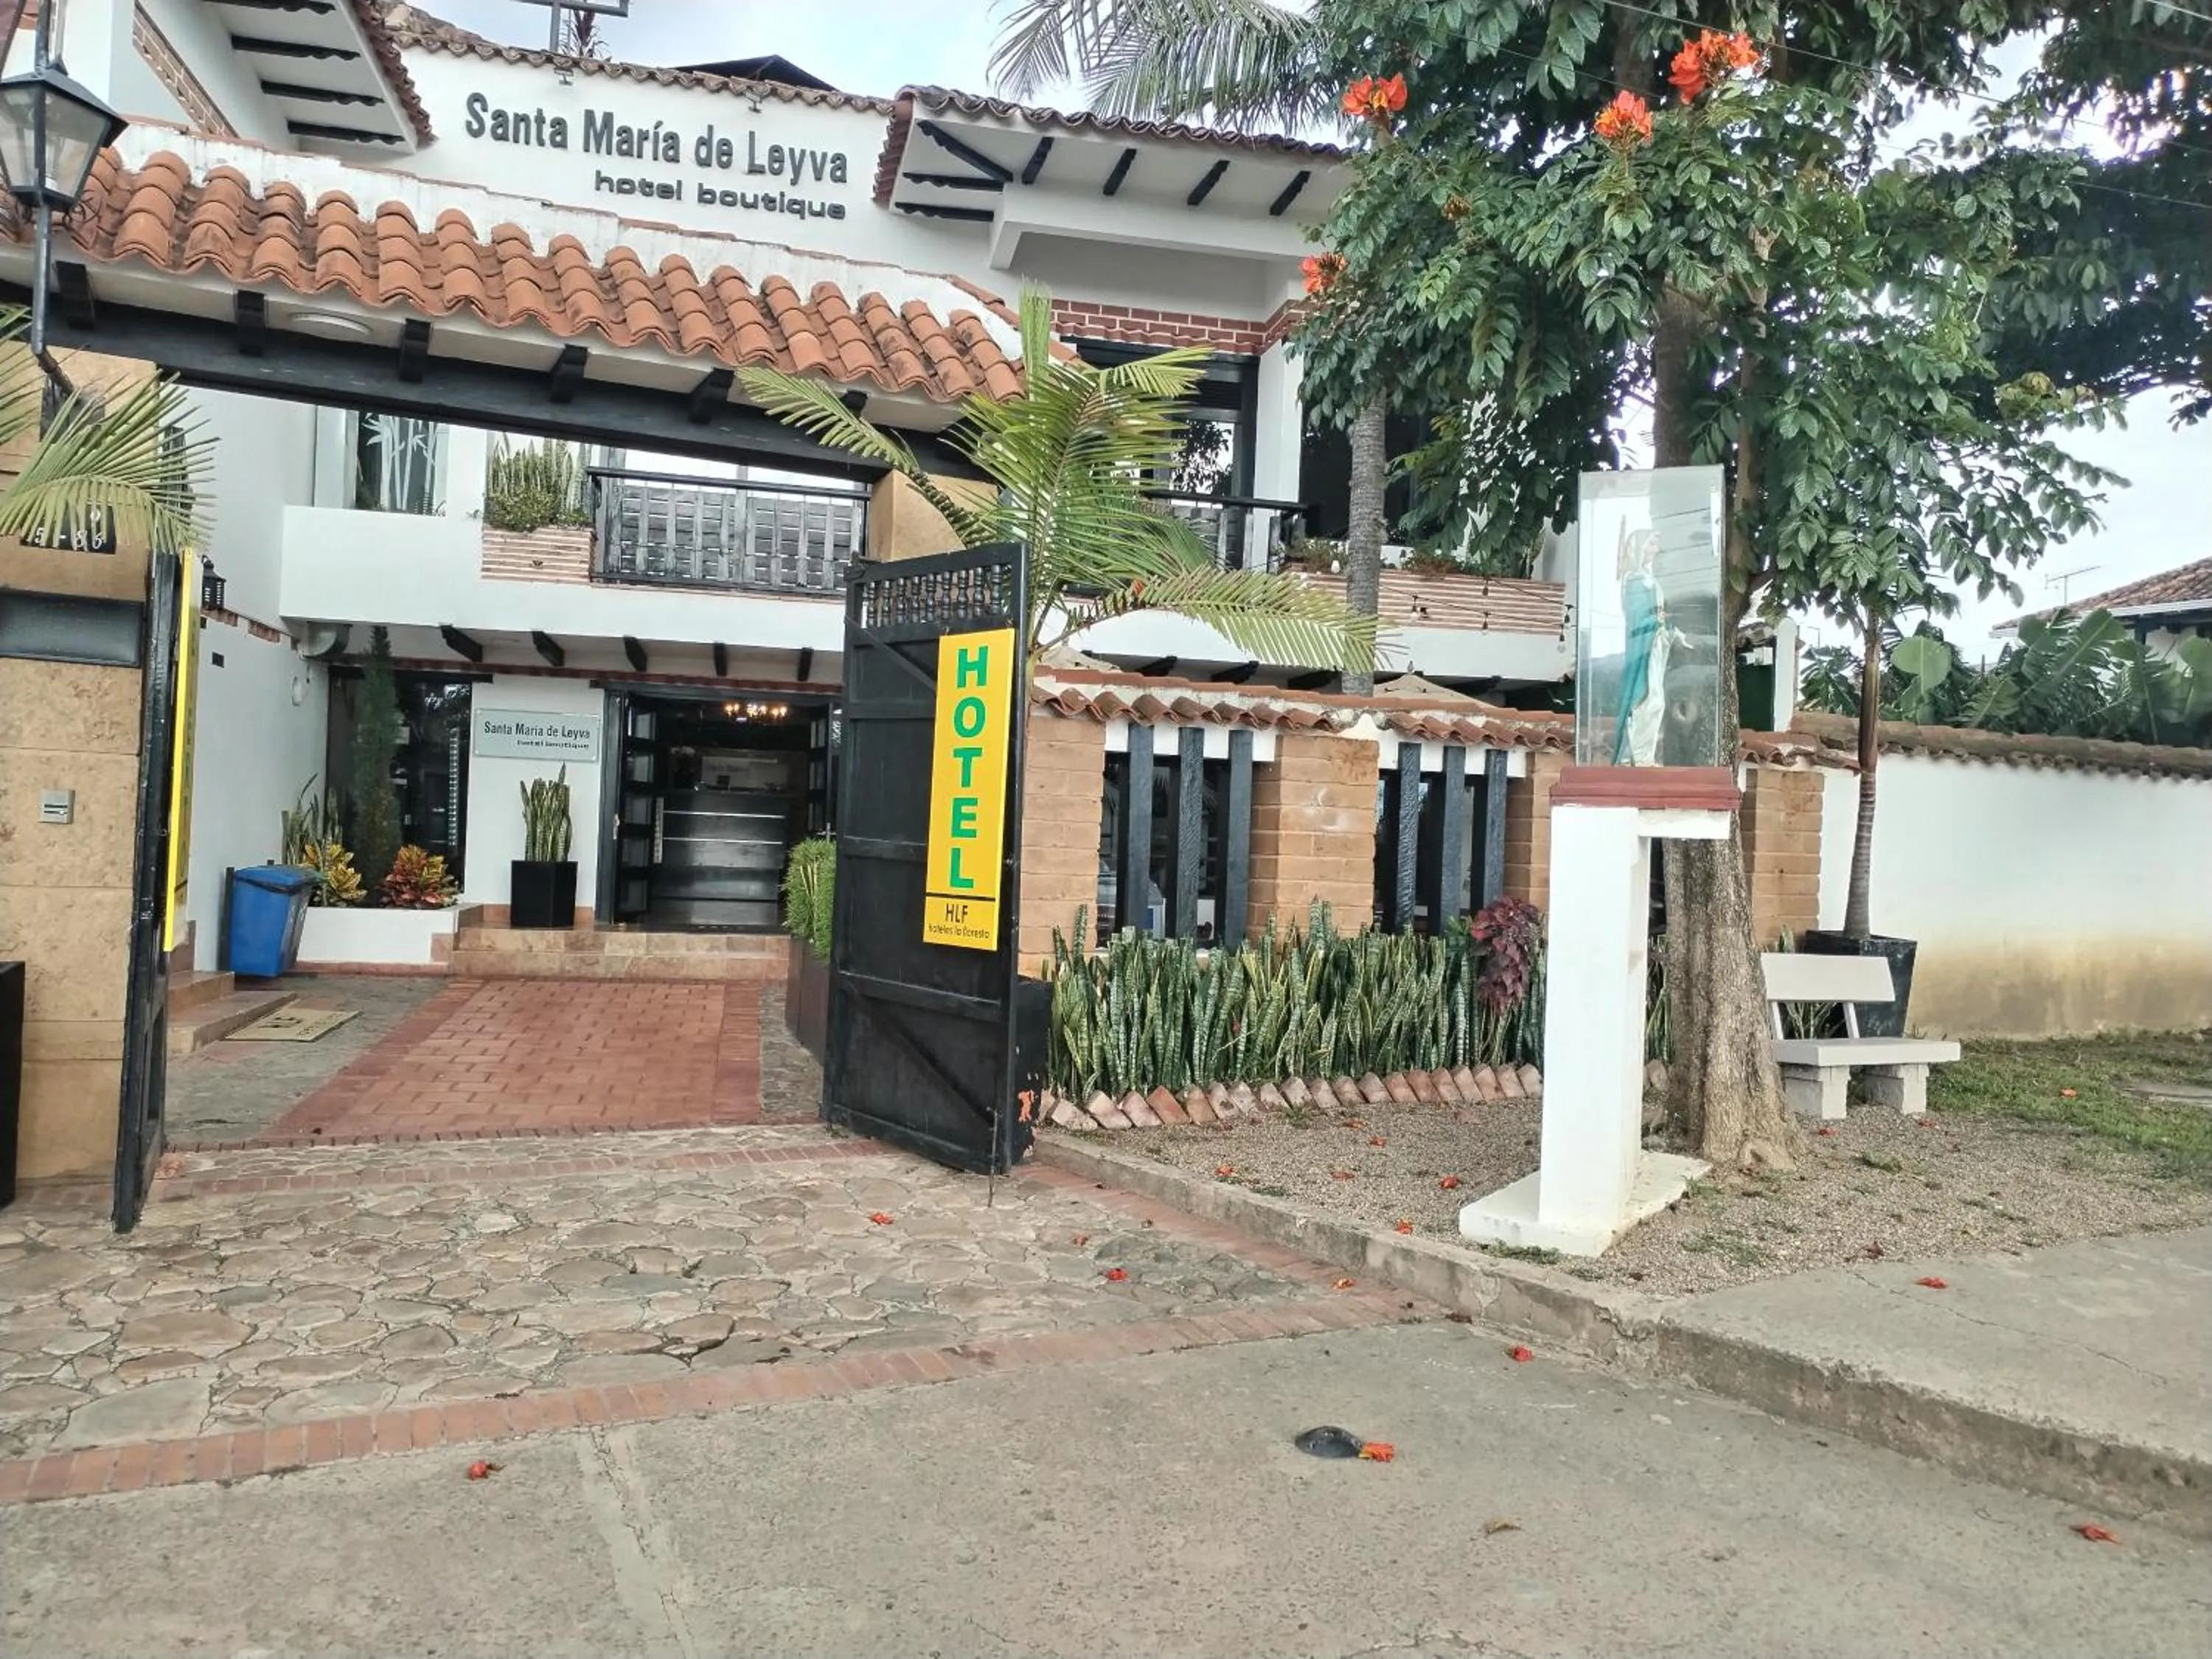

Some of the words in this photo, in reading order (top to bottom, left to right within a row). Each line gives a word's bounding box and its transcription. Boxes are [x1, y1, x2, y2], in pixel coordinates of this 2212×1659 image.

[466, 92, 568, 150] Santa
[583, 109, 680, 164] María
[695, 124, 734, 170] de
[747, 130, 848, 186] Leyva
[594, 170, 683, 201] hotel
[697, 182, 846, 220] boutique
[484, 720, 512, 735] Santa
[546, 725, 559, 737] de
[561, 725, 590, 740] Leyva
[948, 645, 990, 889] HOTEL
[946, 903, 968, 923] HLF
